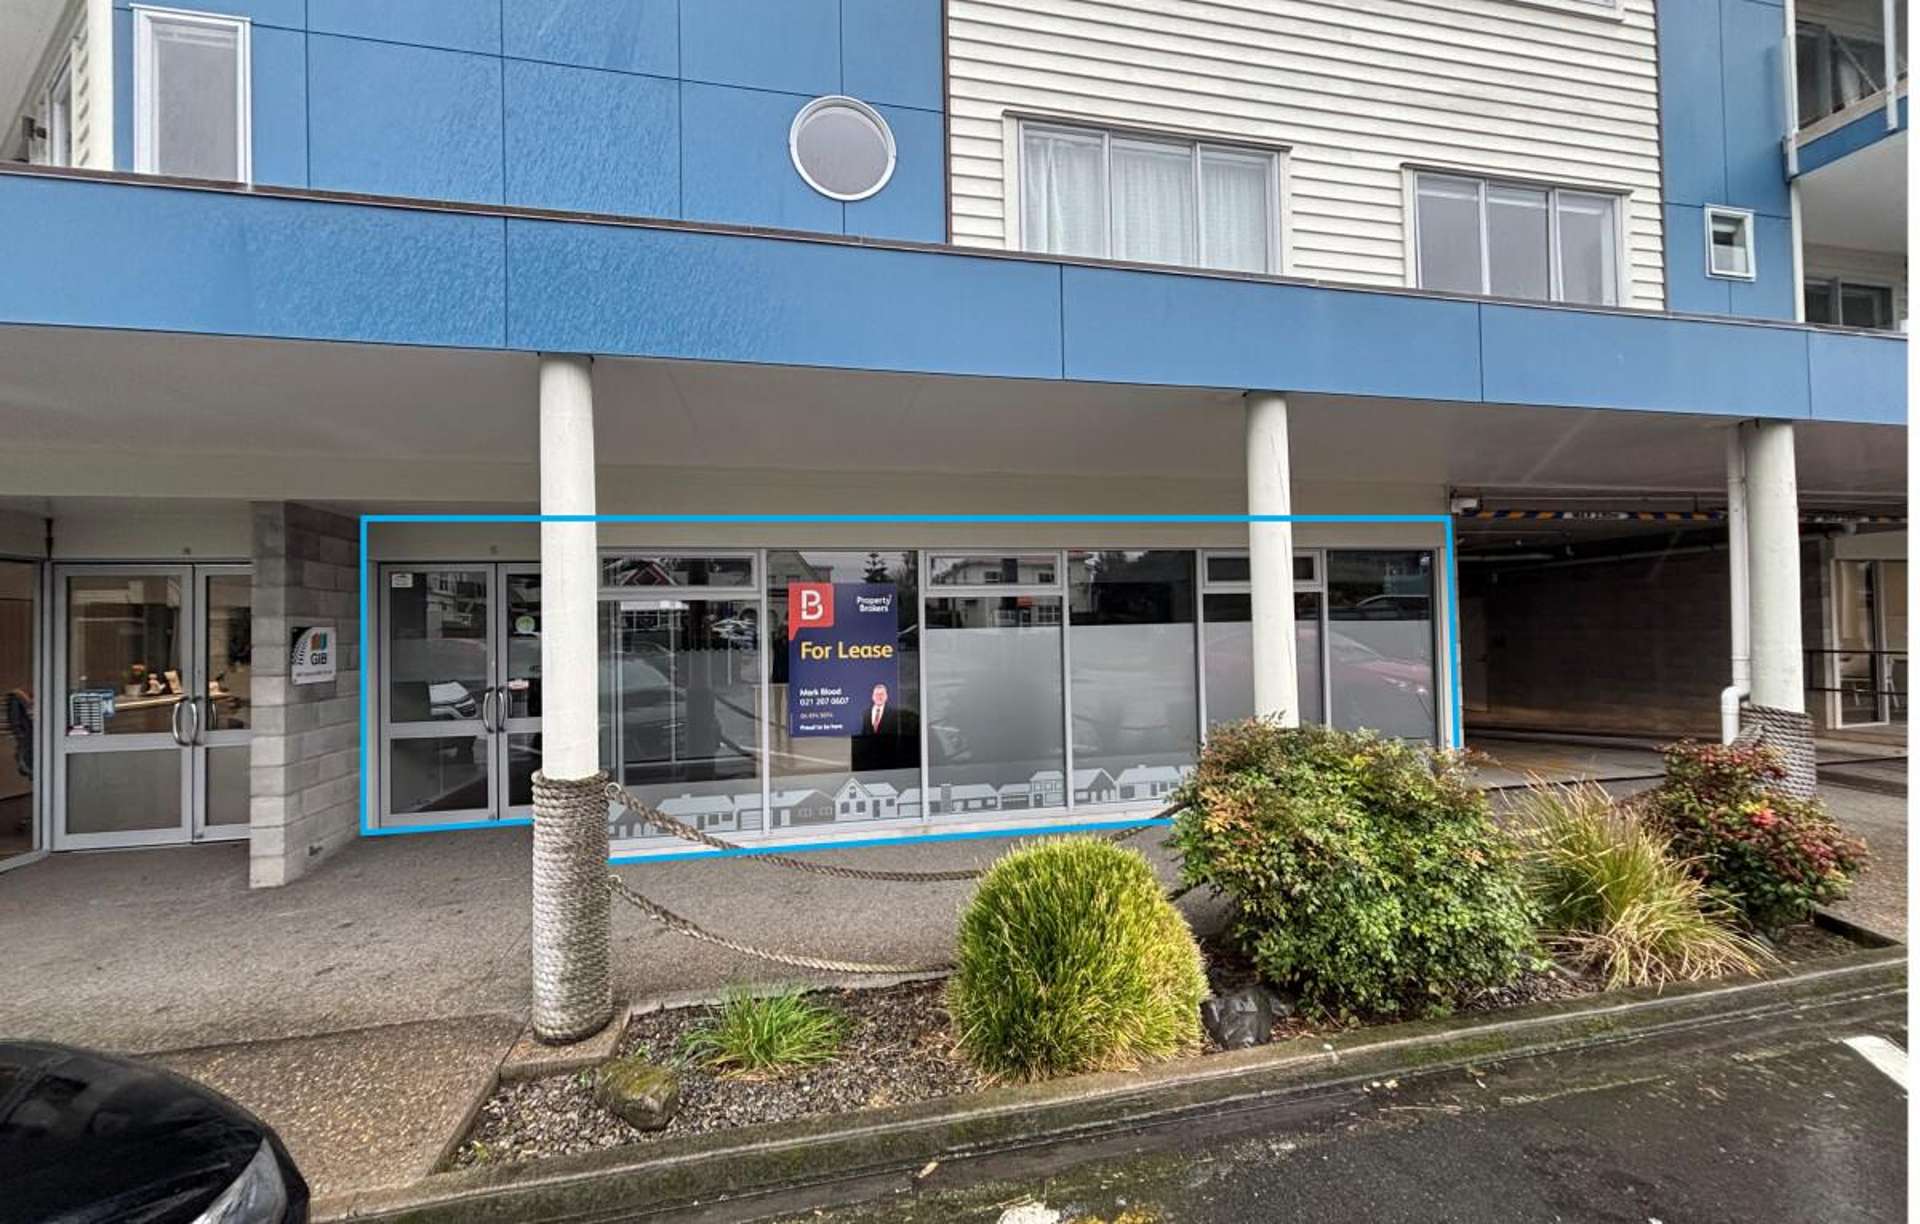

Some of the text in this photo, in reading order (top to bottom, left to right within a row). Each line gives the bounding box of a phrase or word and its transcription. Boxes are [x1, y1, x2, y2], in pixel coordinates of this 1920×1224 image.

[801, 590, 823, 620] B
[856, 594, 892, 606] Property
[859, 604, 889, 613] Brokers
[801, 641, 894, 660] For Lease
[311, 653, 327, 665] GIB
[799, 688, 842, 697] Mark Blood
[799, 697, 814, 707] 021
